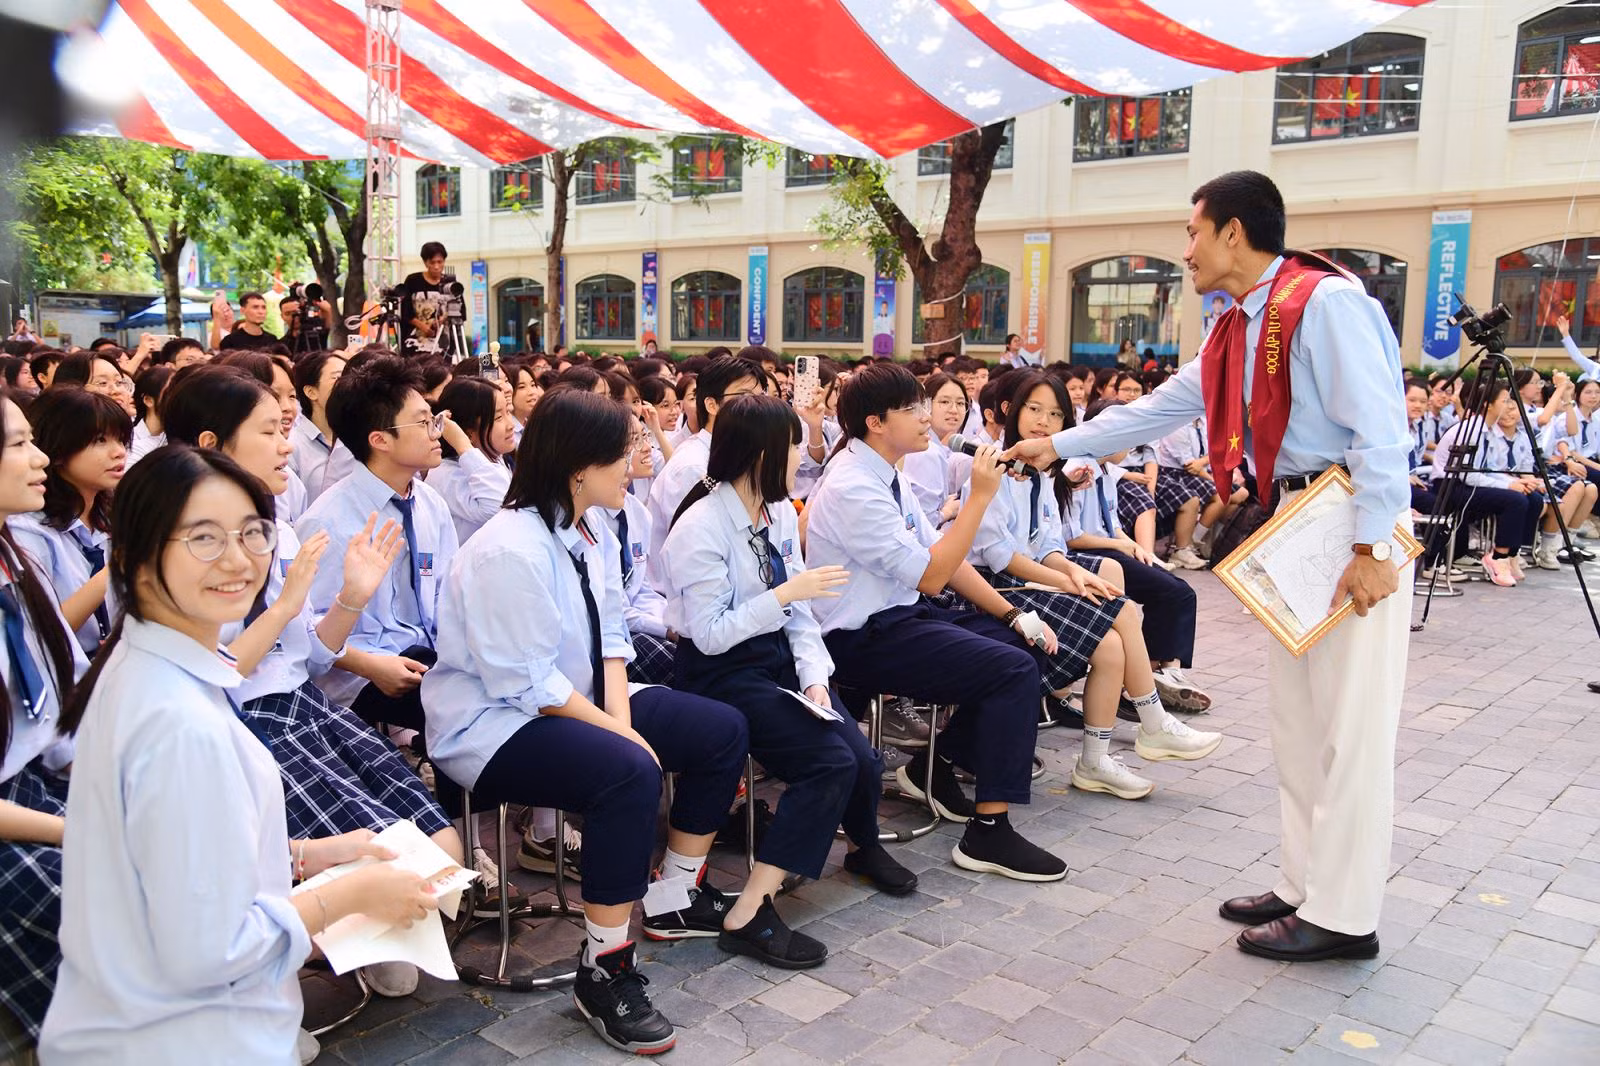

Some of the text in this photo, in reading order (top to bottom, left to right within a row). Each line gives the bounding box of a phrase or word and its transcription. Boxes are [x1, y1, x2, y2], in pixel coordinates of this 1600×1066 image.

[753, 267, 762, 335] CONFIDENT
[1028, 251, 1041, 344] RESPONSIBLE
[1434, 240, 1457, 341] REFLECTIVE
